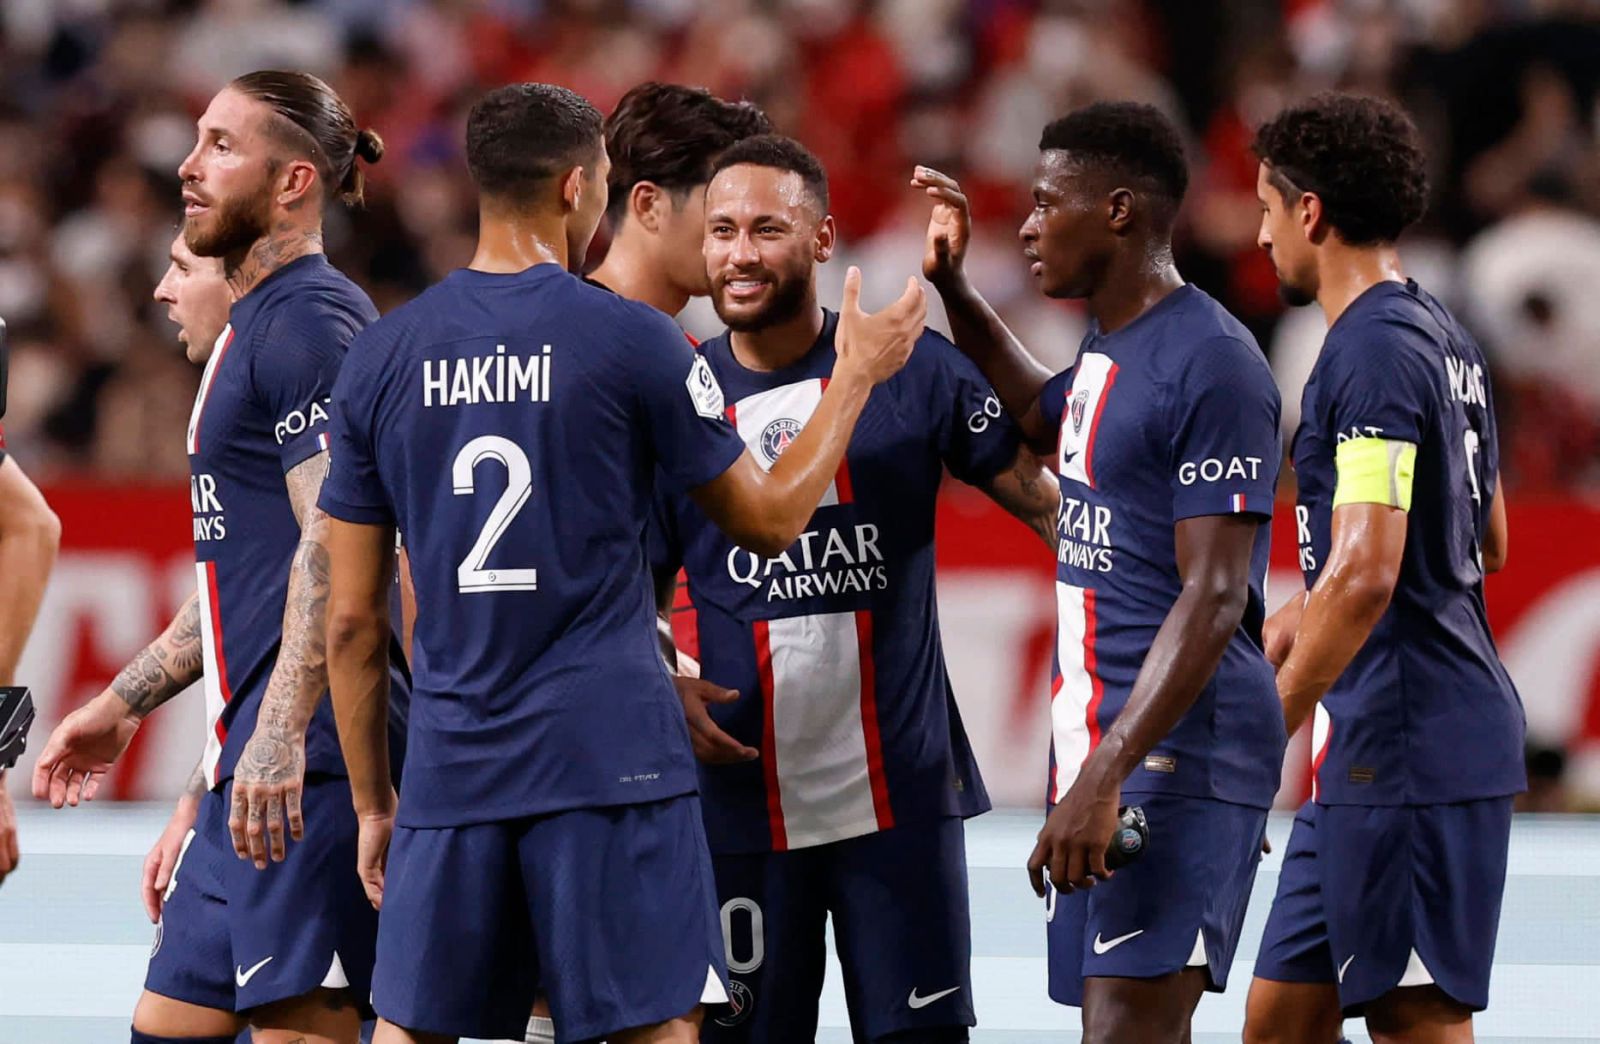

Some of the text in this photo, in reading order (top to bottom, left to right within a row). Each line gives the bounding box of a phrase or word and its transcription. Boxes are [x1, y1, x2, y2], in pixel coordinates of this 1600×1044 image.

[1178, 456, 1263, 486] GOAT
[452, 434, 538, 594] 2
[767, 565, 889, 603] AIRWAYS
